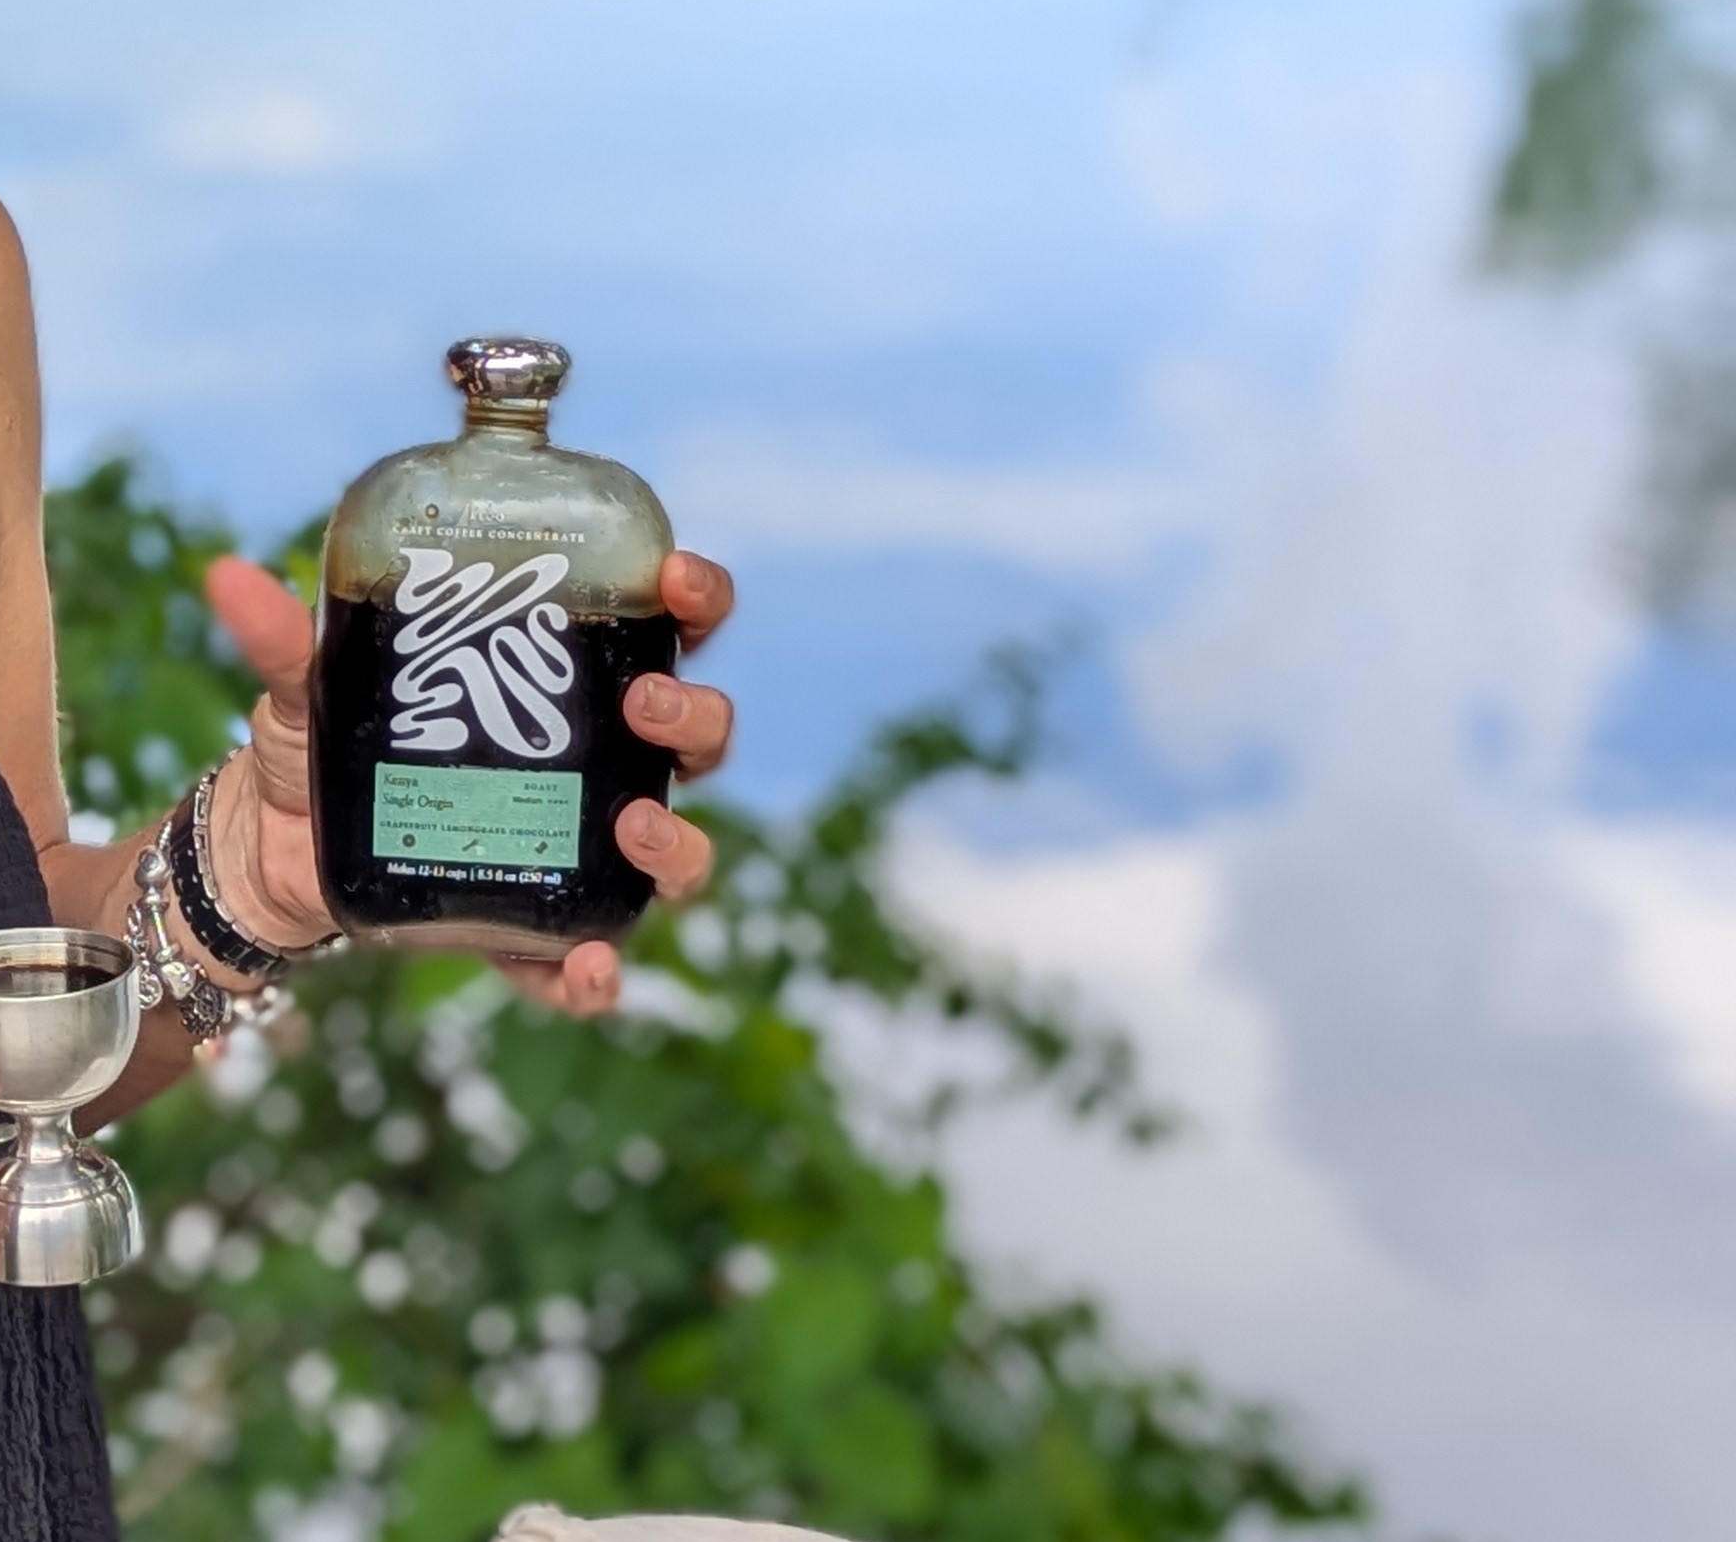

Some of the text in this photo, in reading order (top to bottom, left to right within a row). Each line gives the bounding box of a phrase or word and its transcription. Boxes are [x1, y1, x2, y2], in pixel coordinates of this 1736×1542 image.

[436, 527, 483, 538] COFFEE
[488, 530, 585, 543] CONCENTRATE
[524, 782, 558, 792] ROAST
[382, 792, 454, 811] Single Origin
[380, 820, 570, 837] GRAPEFRUIT LEMONGRASS CHOCOLATE
